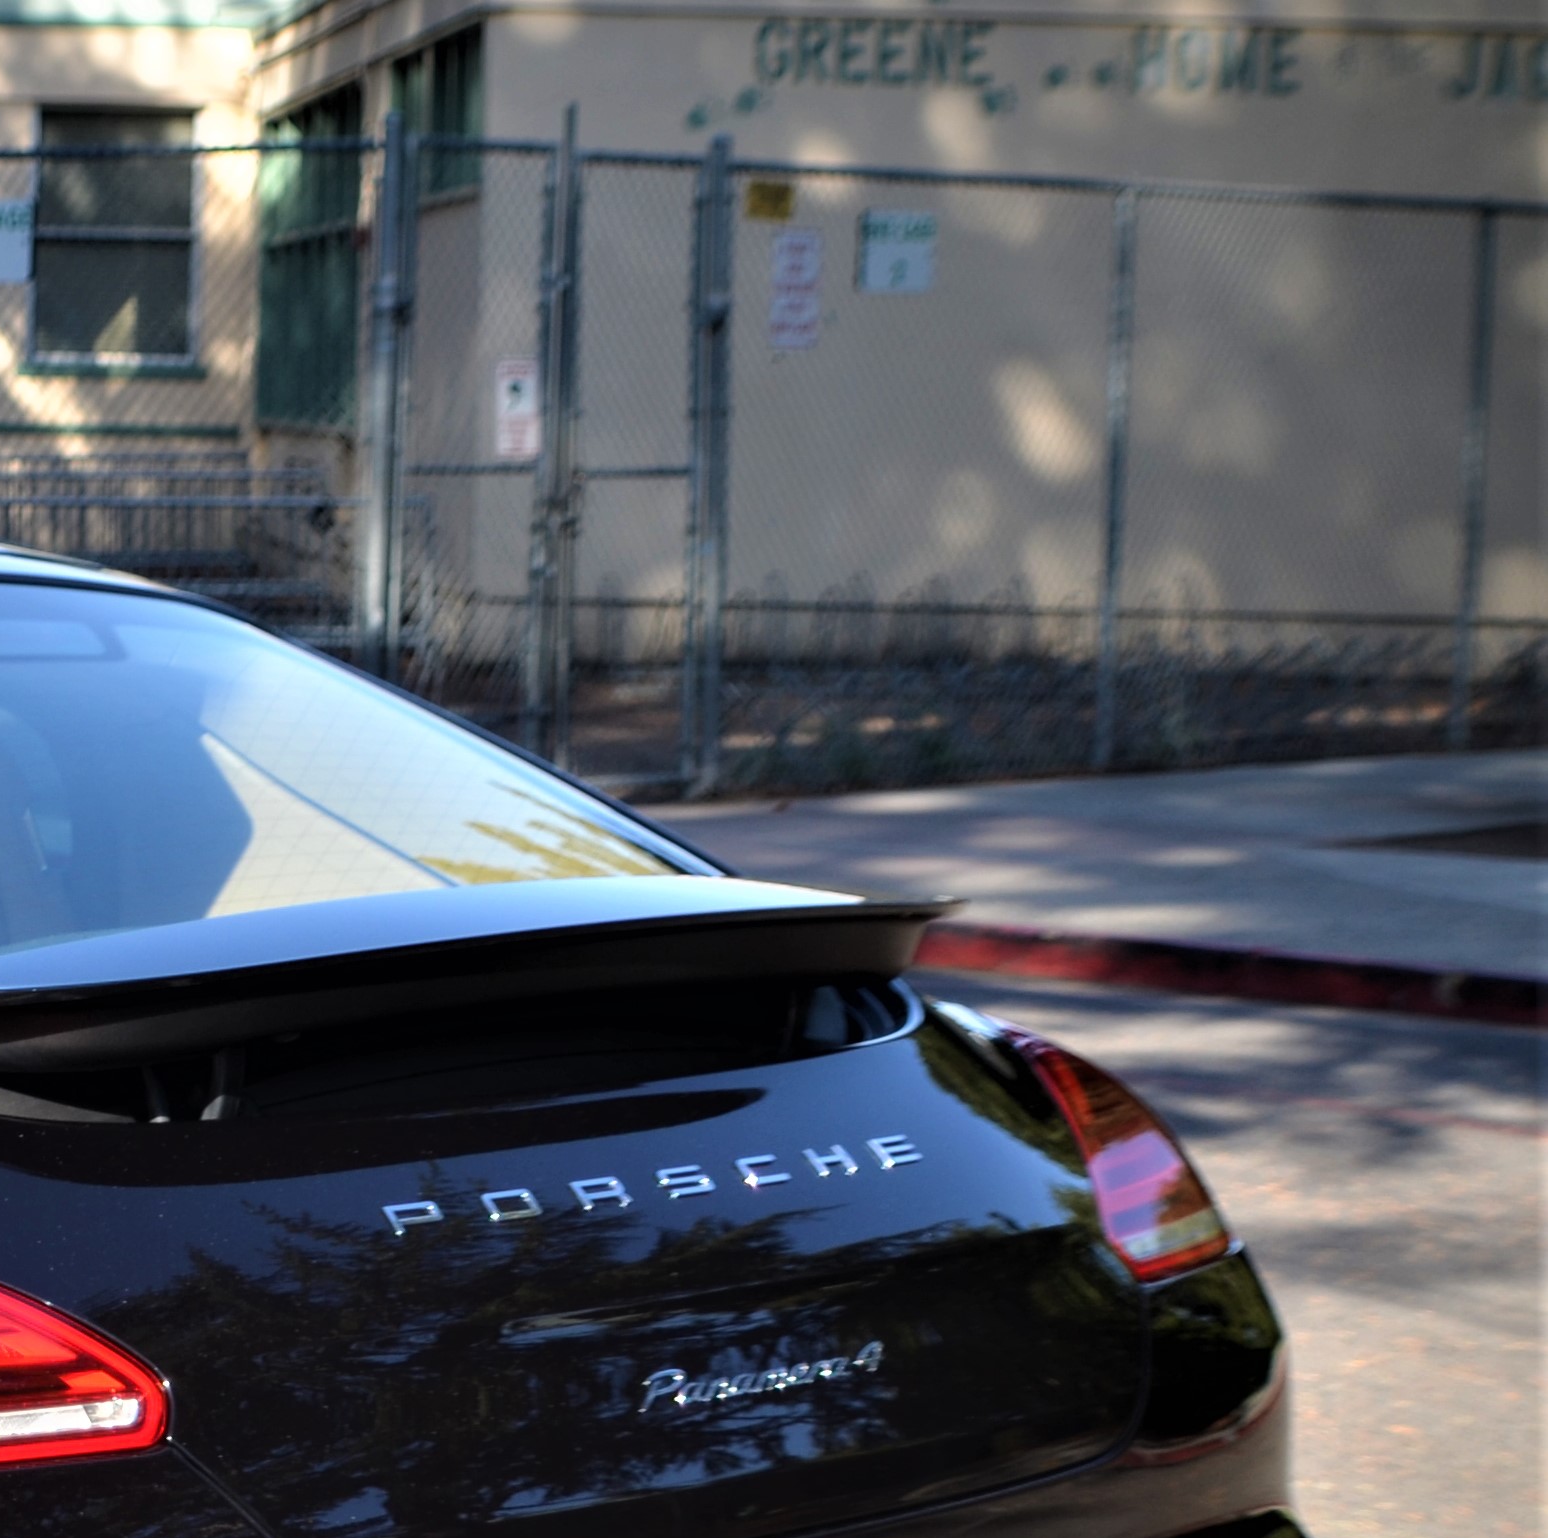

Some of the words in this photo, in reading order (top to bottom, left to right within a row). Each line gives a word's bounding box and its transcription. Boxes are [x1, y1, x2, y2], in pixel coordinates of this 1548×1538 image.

[753, 16, 999, 86] GREENE
[1129, 24, 1302, 98] HOME
[381, 1133, 923, 1237] PORSCHE
